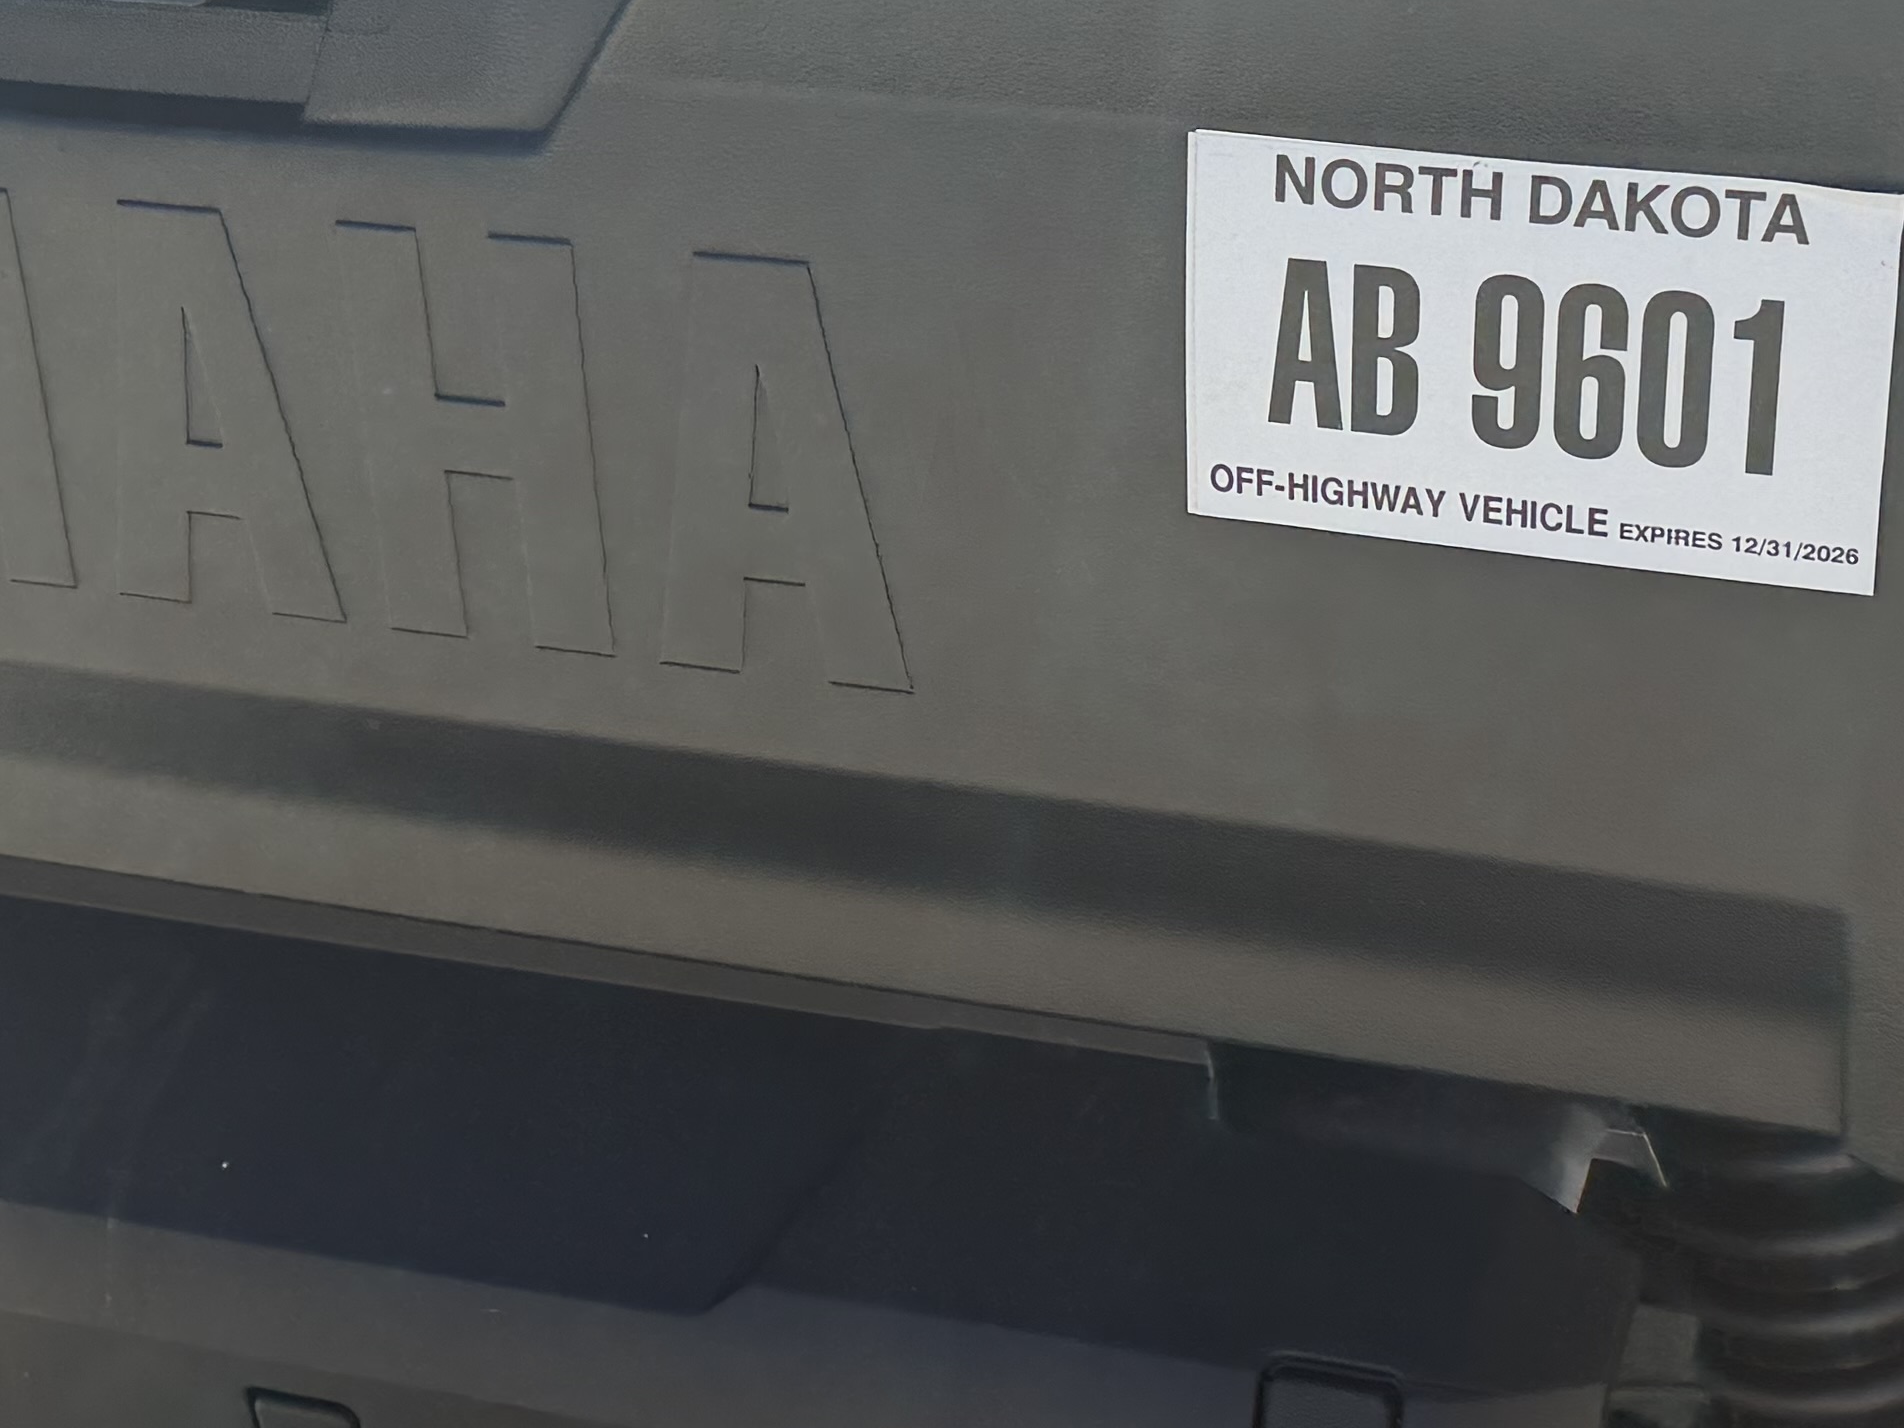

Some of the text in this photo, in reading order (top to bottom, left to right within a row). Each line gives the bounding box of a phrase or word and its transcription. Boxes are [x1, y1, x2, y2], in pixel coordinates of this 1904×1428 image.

[1274, 154, 1810, 245] NORTH DAKOTA
[1267, 257, 1786, 477] AB 9601
[1209, 462, 1860, 566] OFF-HIGHWAY VEHICLE EXPIRES 12/31/2026
